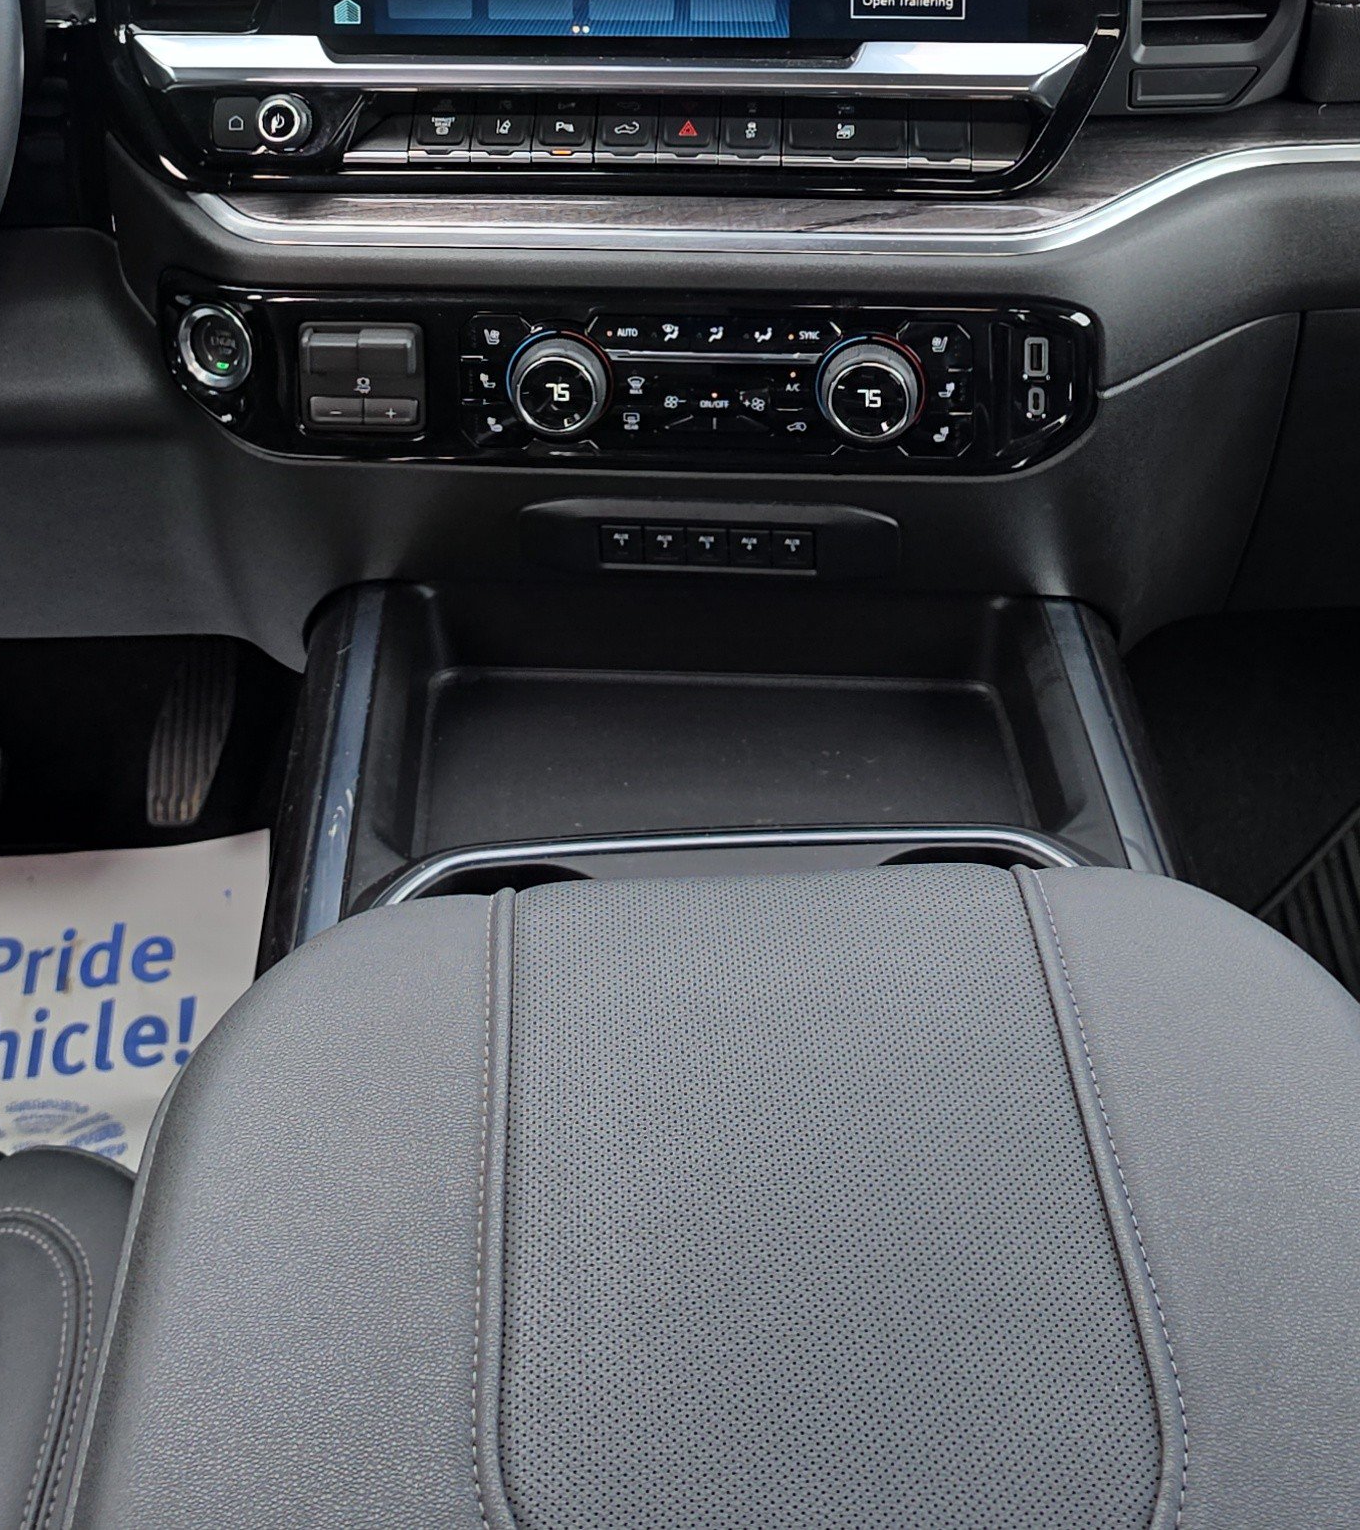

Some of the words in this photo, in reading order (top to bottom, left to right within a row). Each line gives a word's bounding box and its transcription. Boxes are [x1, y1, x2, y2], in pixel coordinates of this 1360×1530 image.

[617, 327, 638, 338] AUTO
[798, 330, 821, 341] SYNC
[545, 383, 570, 402] 75
[785, 383, 801, 392] A/C
[857, 389, 882, 408] 75
[699, 399, 730, 410] ON/OFF
